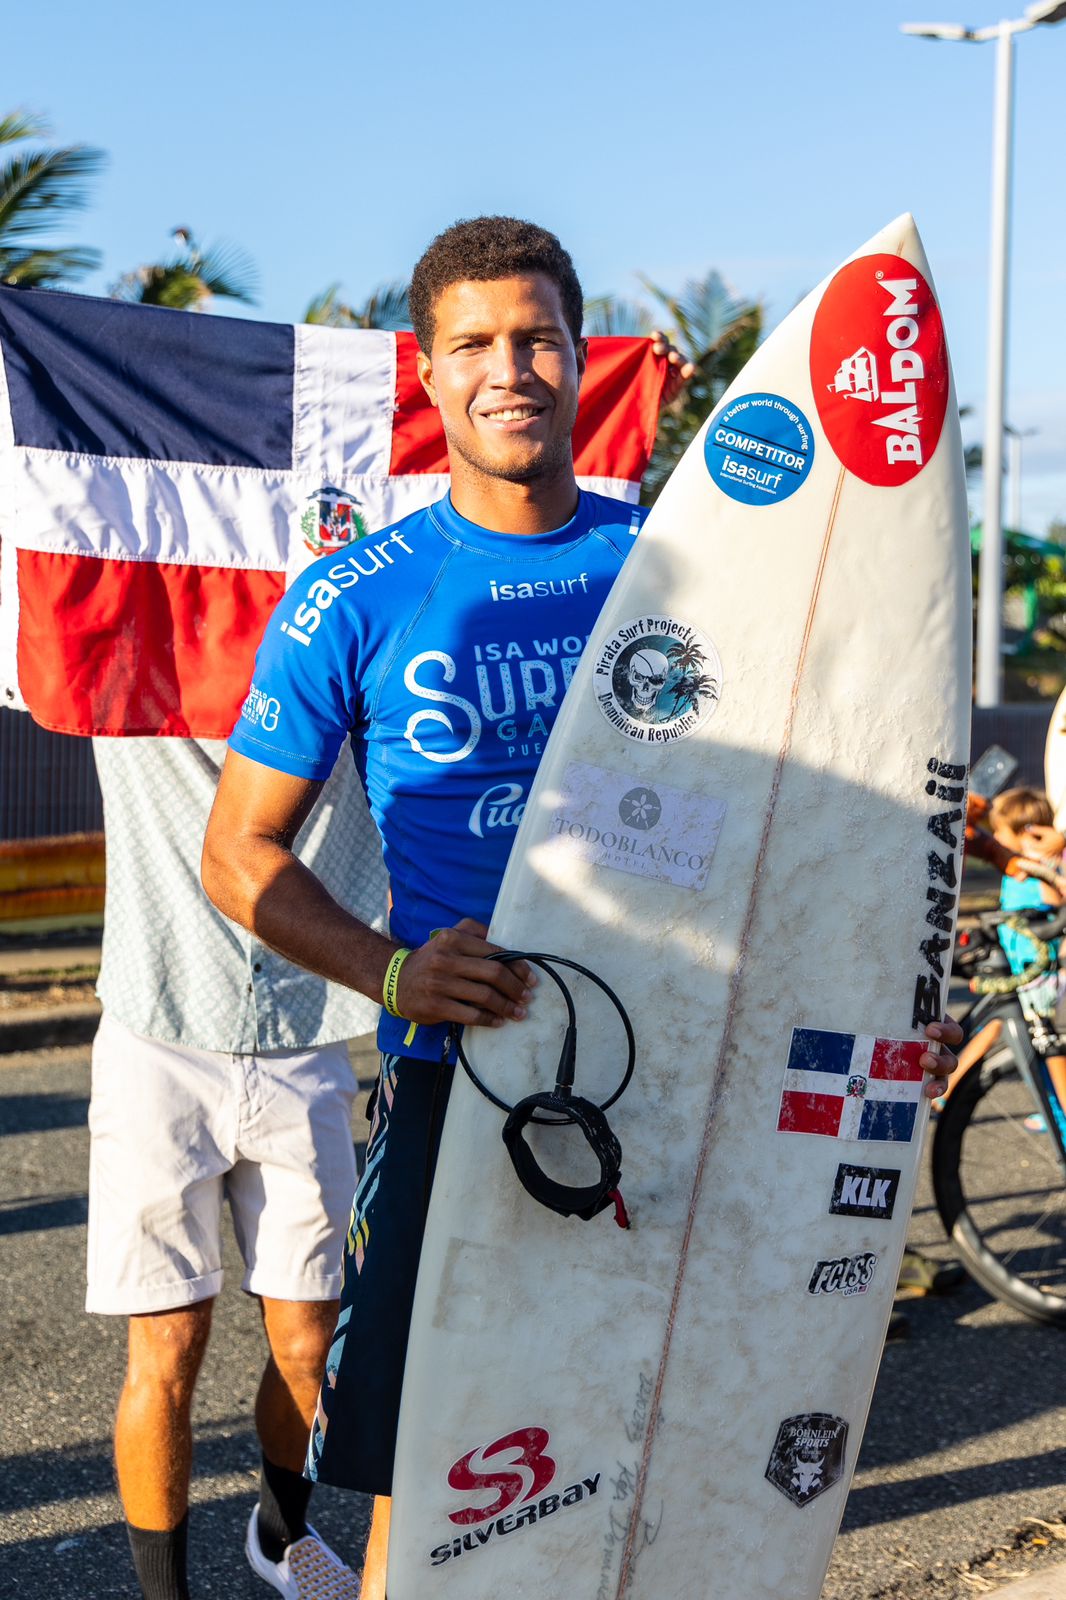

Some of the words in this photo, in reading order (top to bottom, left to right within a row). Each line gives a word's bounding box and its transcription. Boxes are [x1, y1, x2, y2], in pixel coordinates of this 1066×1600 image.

[870, 278, 924, 465] BALDOM
[727, 401, 750, 417] better
[751, 399, 773, 407] world
[774, 402, 800, 424] through
[797, 423, 809, 451] surfing
[714, 429, 805, 470] COMPETITOR
[722, 454, 783, 488] isasurf
[280, 530, 414, 647] isasurf
[489, 572, 589, 602] isasurf
[474, 641, 524, 662] ISA
[533, 634, 591, 656] WO
[595, 638, 621, 676] Pirata
[618, 619, 645, 642] Surf
[646, 618, 692, 641] Project
[598, 692, 645, 740] Dominican
[648, 714, 697, 743] Republic
[508, 742, 541, 758] PUE
[555, 817, 704, 871] TODOBLANCO
[386, 957, 401, 1015] MPETITOR
[840, 1175, 891, 1208] KLK
[808, 1253, 876, 1294] FCLSS
[844, 1286, 858, 1296] USA
[794, 1437, 830, 1448] SPORTS
